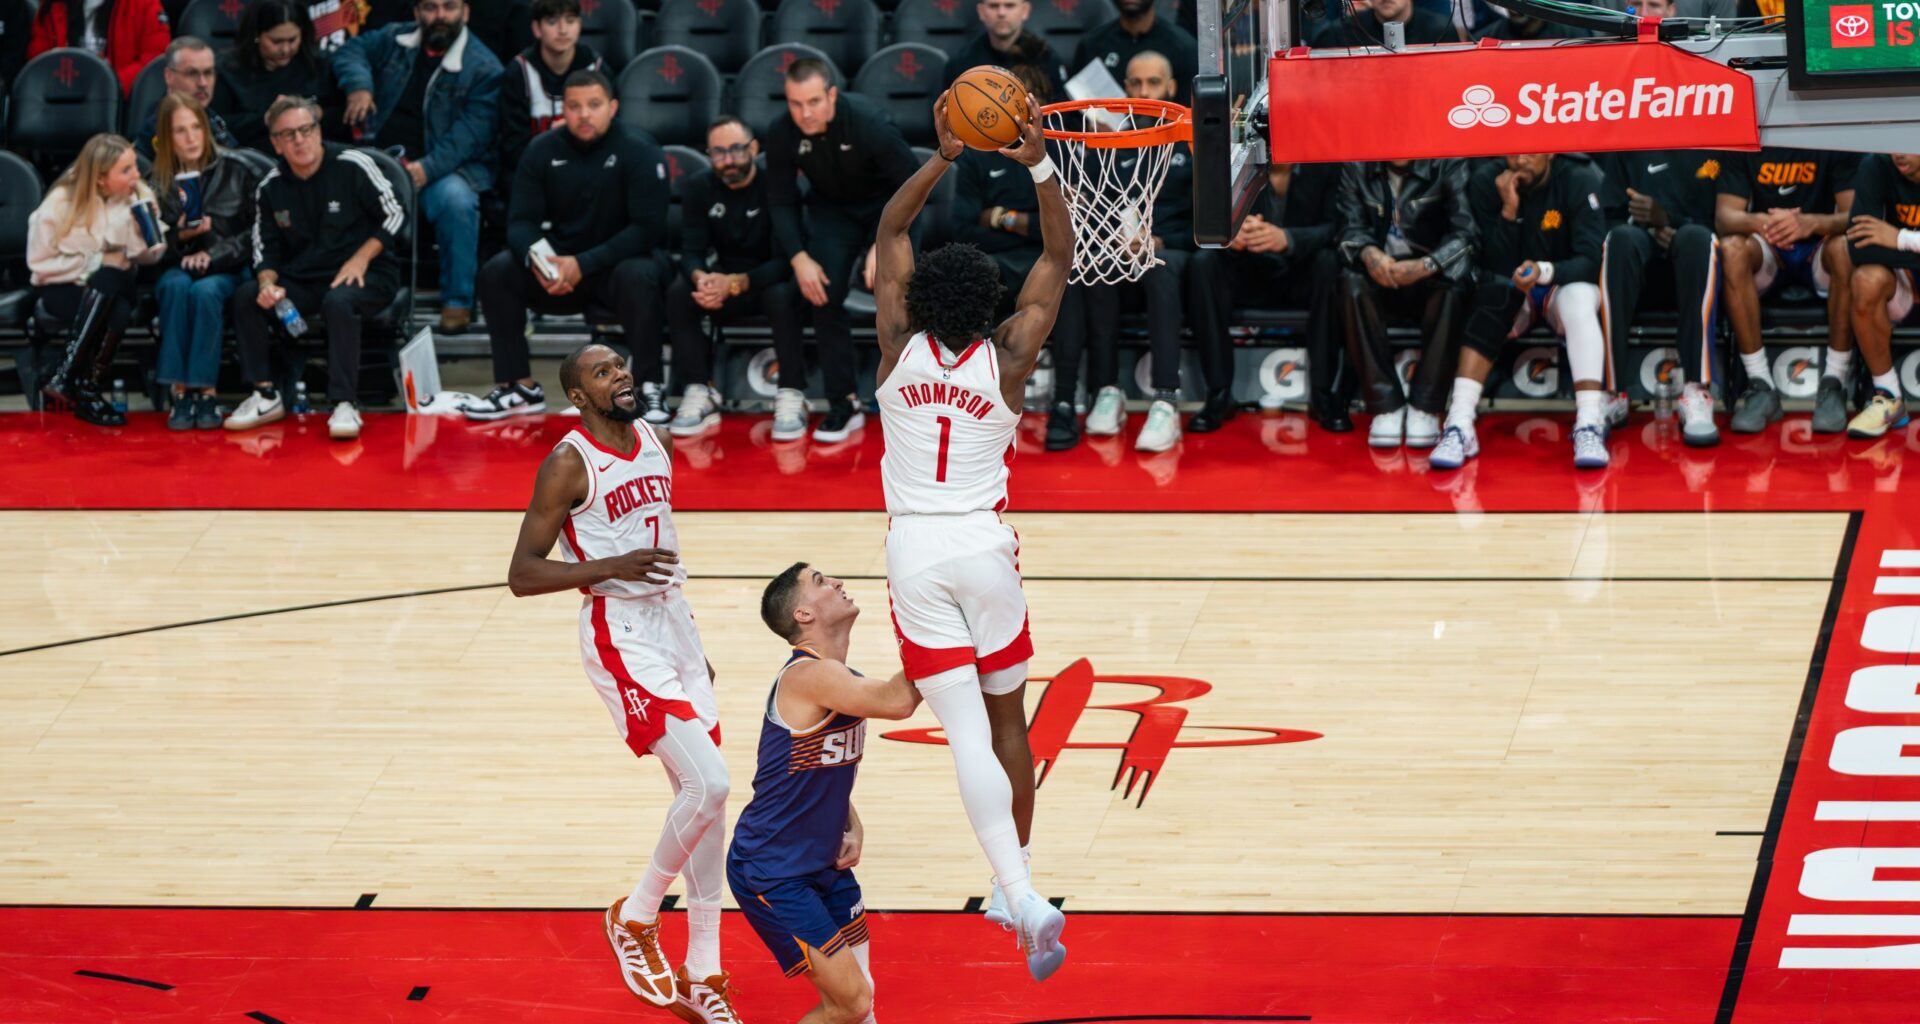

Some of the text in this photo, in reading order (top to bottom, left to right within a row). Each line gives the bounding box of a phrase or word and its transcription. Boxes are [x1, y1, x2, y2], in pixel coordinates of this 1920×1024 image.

[1887, 21, 1915, 46] IS
[1259, 347, 1306, 399] G
[1513, 347, 1560, 398] G
[1773, 347, 1819, 398] G
[898, 382, 995, 421] THOMPSON
[935, 415, 951, 483] 1
[644, 515, 659, 549] 7
